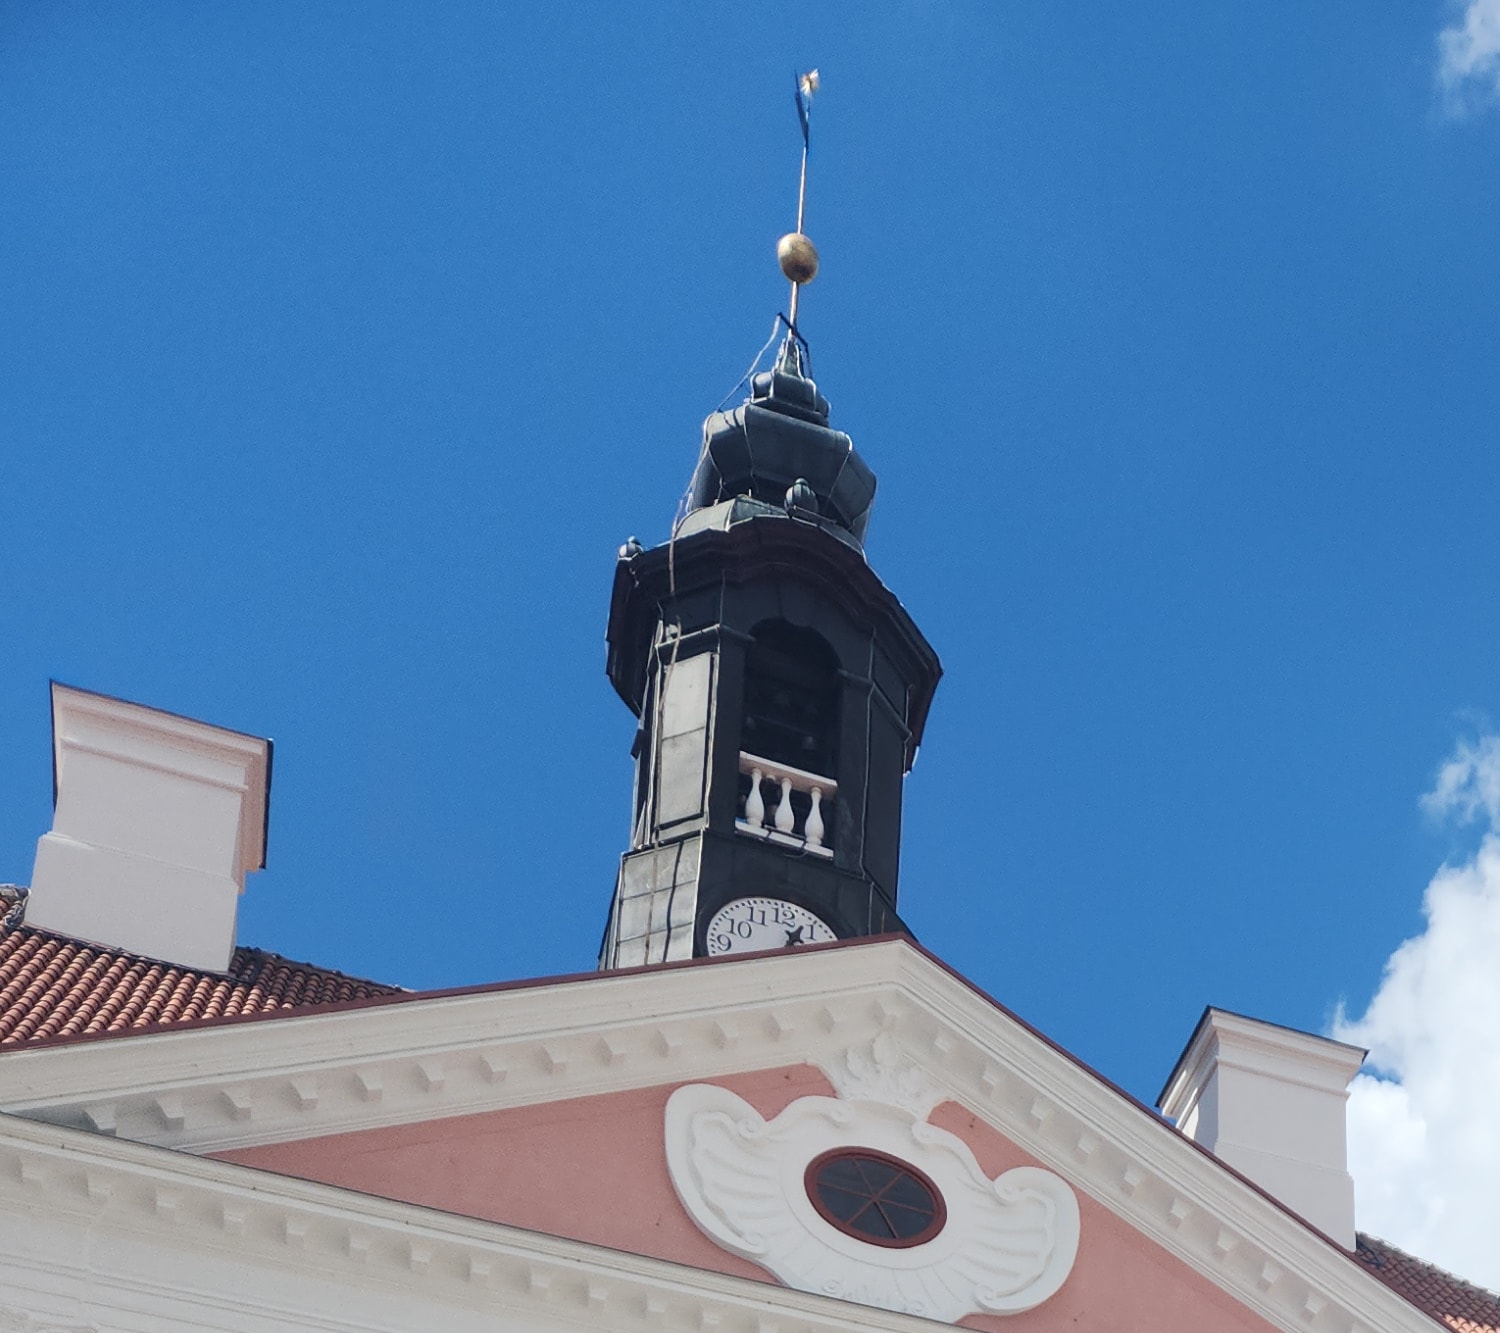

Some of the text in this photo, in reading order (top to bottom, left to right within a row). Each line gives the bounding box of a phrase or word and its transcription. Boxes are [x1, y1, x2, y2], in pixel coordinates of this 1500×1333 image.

[746, 906, 768, 927] 11
[771, 907, 796, 928] 12
[726, 918, 752, 939] 10
[803, 924, 816, 940] 1
[716, 933, 732, 952] 9
